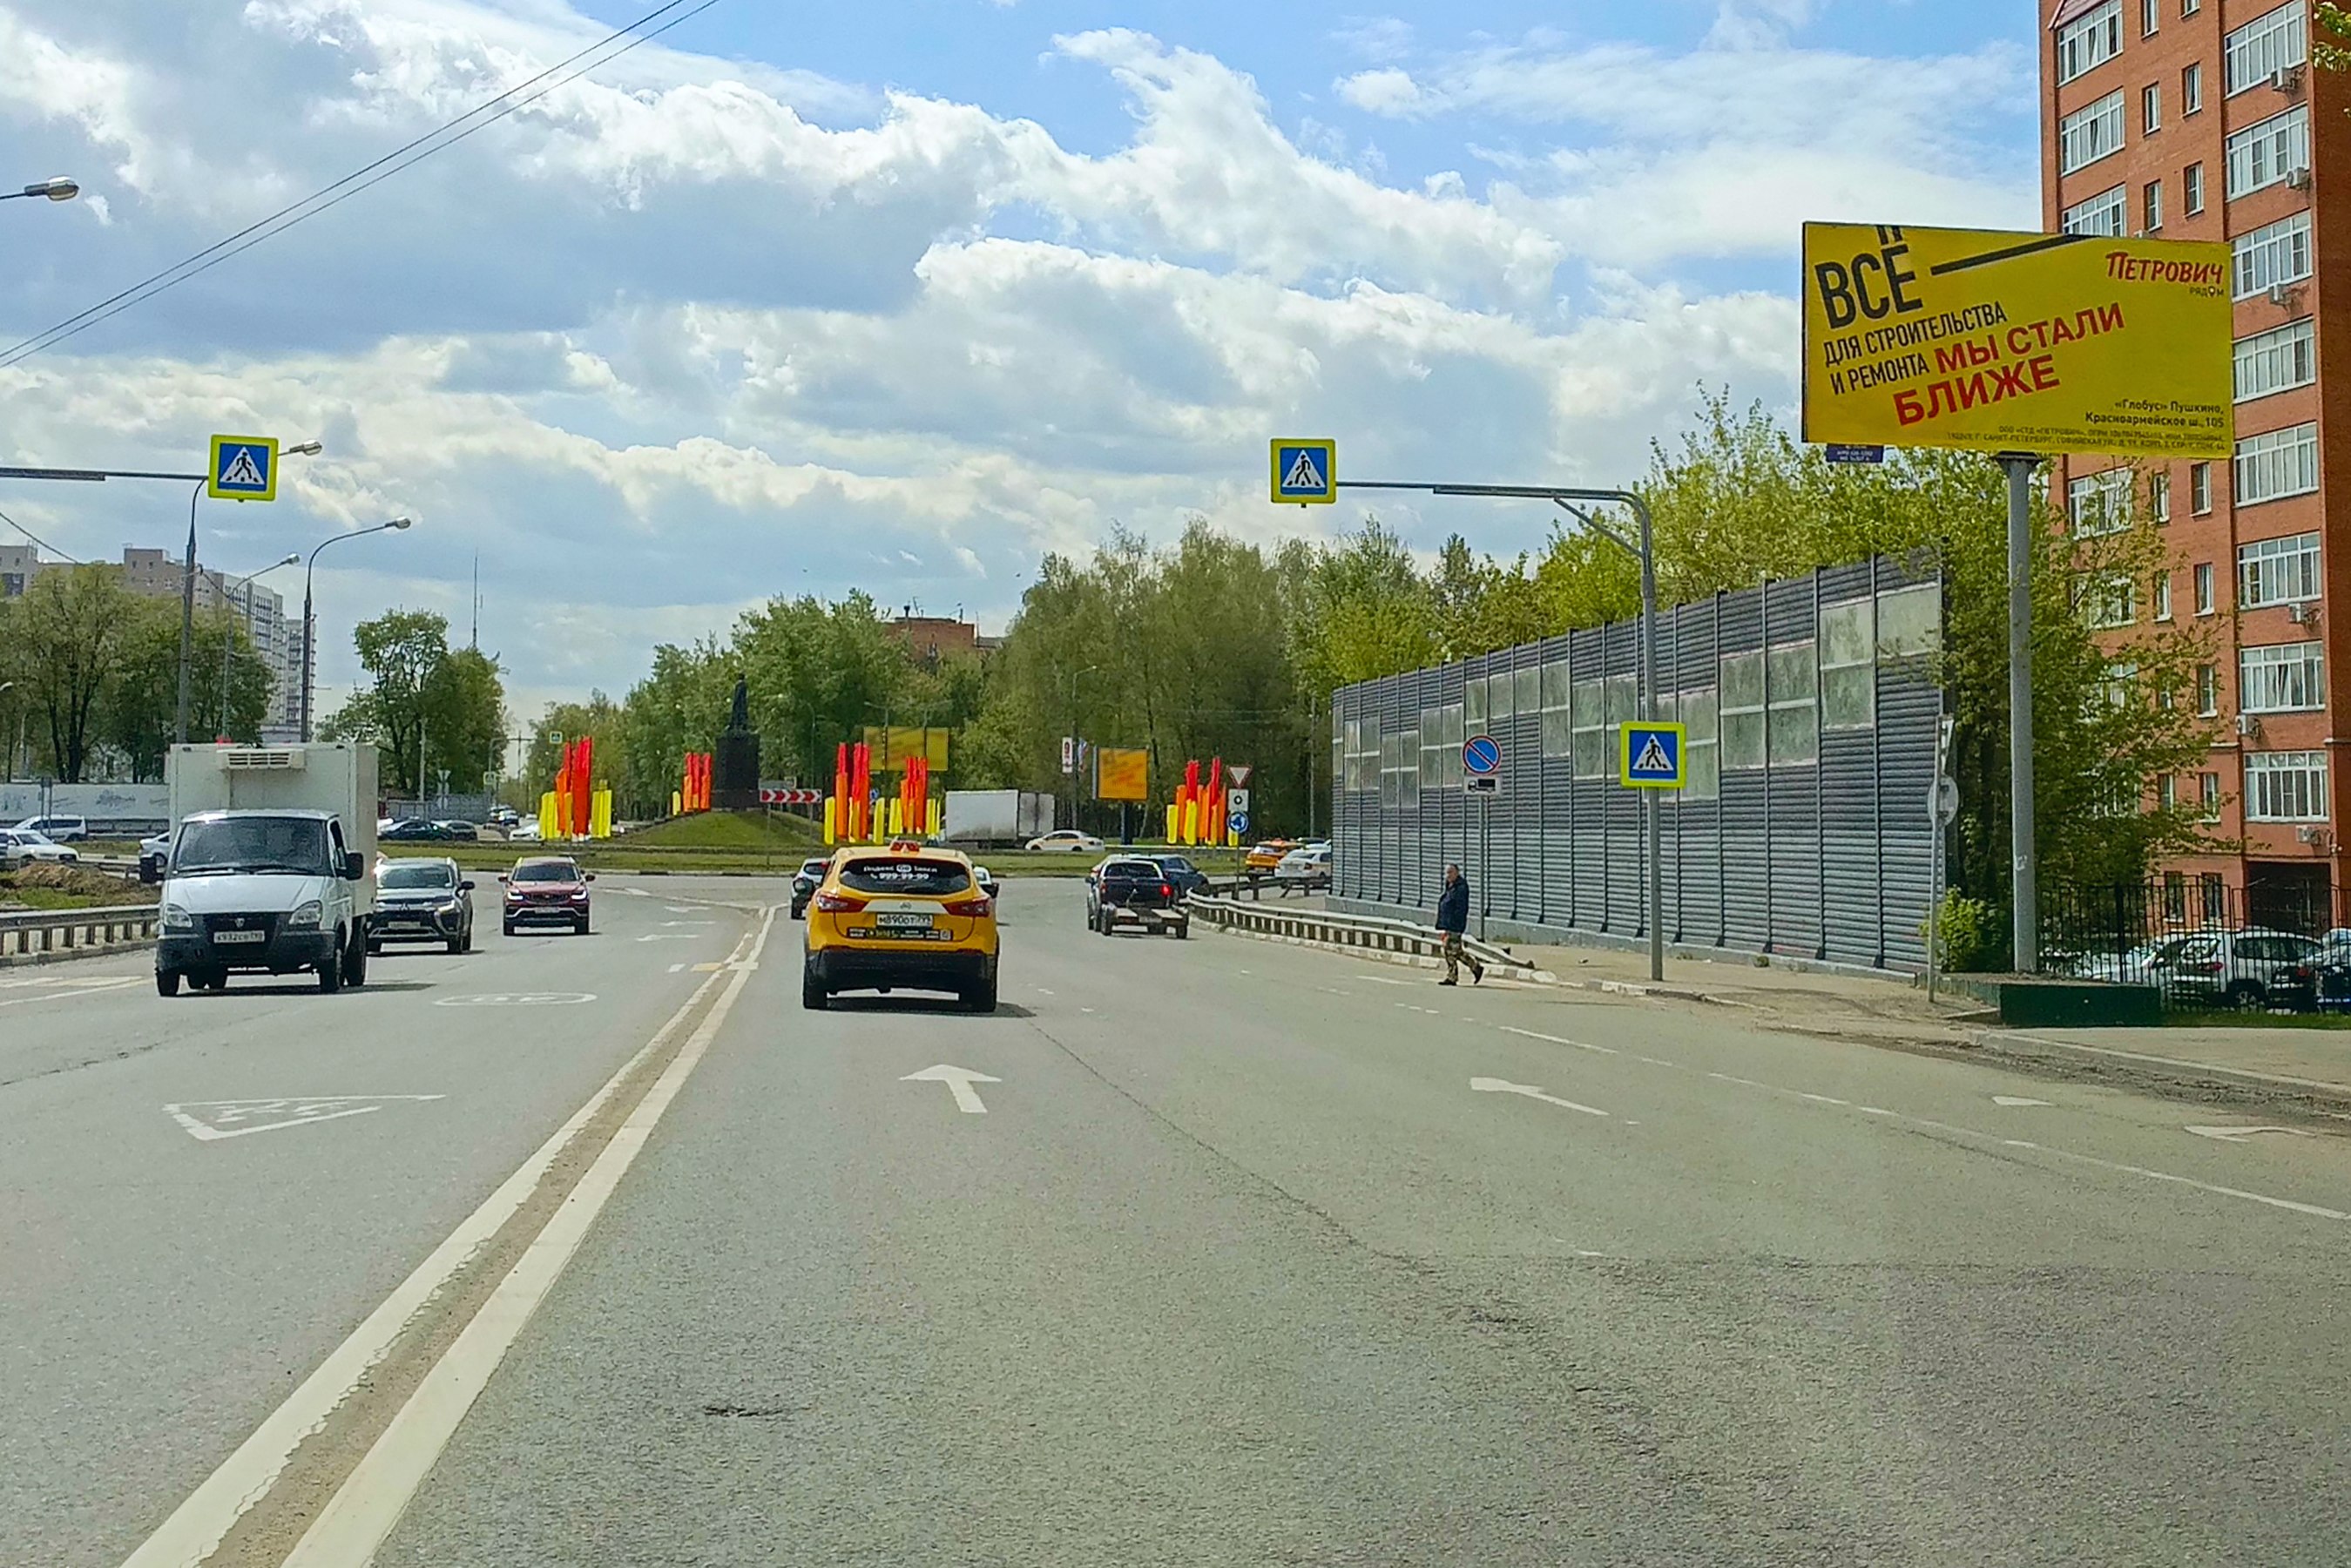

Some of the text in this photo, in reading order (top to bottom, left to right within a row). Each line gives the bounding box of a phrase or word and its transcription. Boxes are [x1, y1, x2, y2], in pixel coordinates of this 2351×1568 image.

[1823, 301, 2007, 368] ДЛЯ СТРОИТЕЛЬСТВА
[1934, 302, 2125, 374] МЫ СТАЛИ
[1830, 353, 1929, 395] И РЕМОНТА
[1893, 355, 2060, 426] БЛИЖЕ
[2085, 412, 2185, 427] Красноармейское
[2206, 417, 2225, 428] 105
